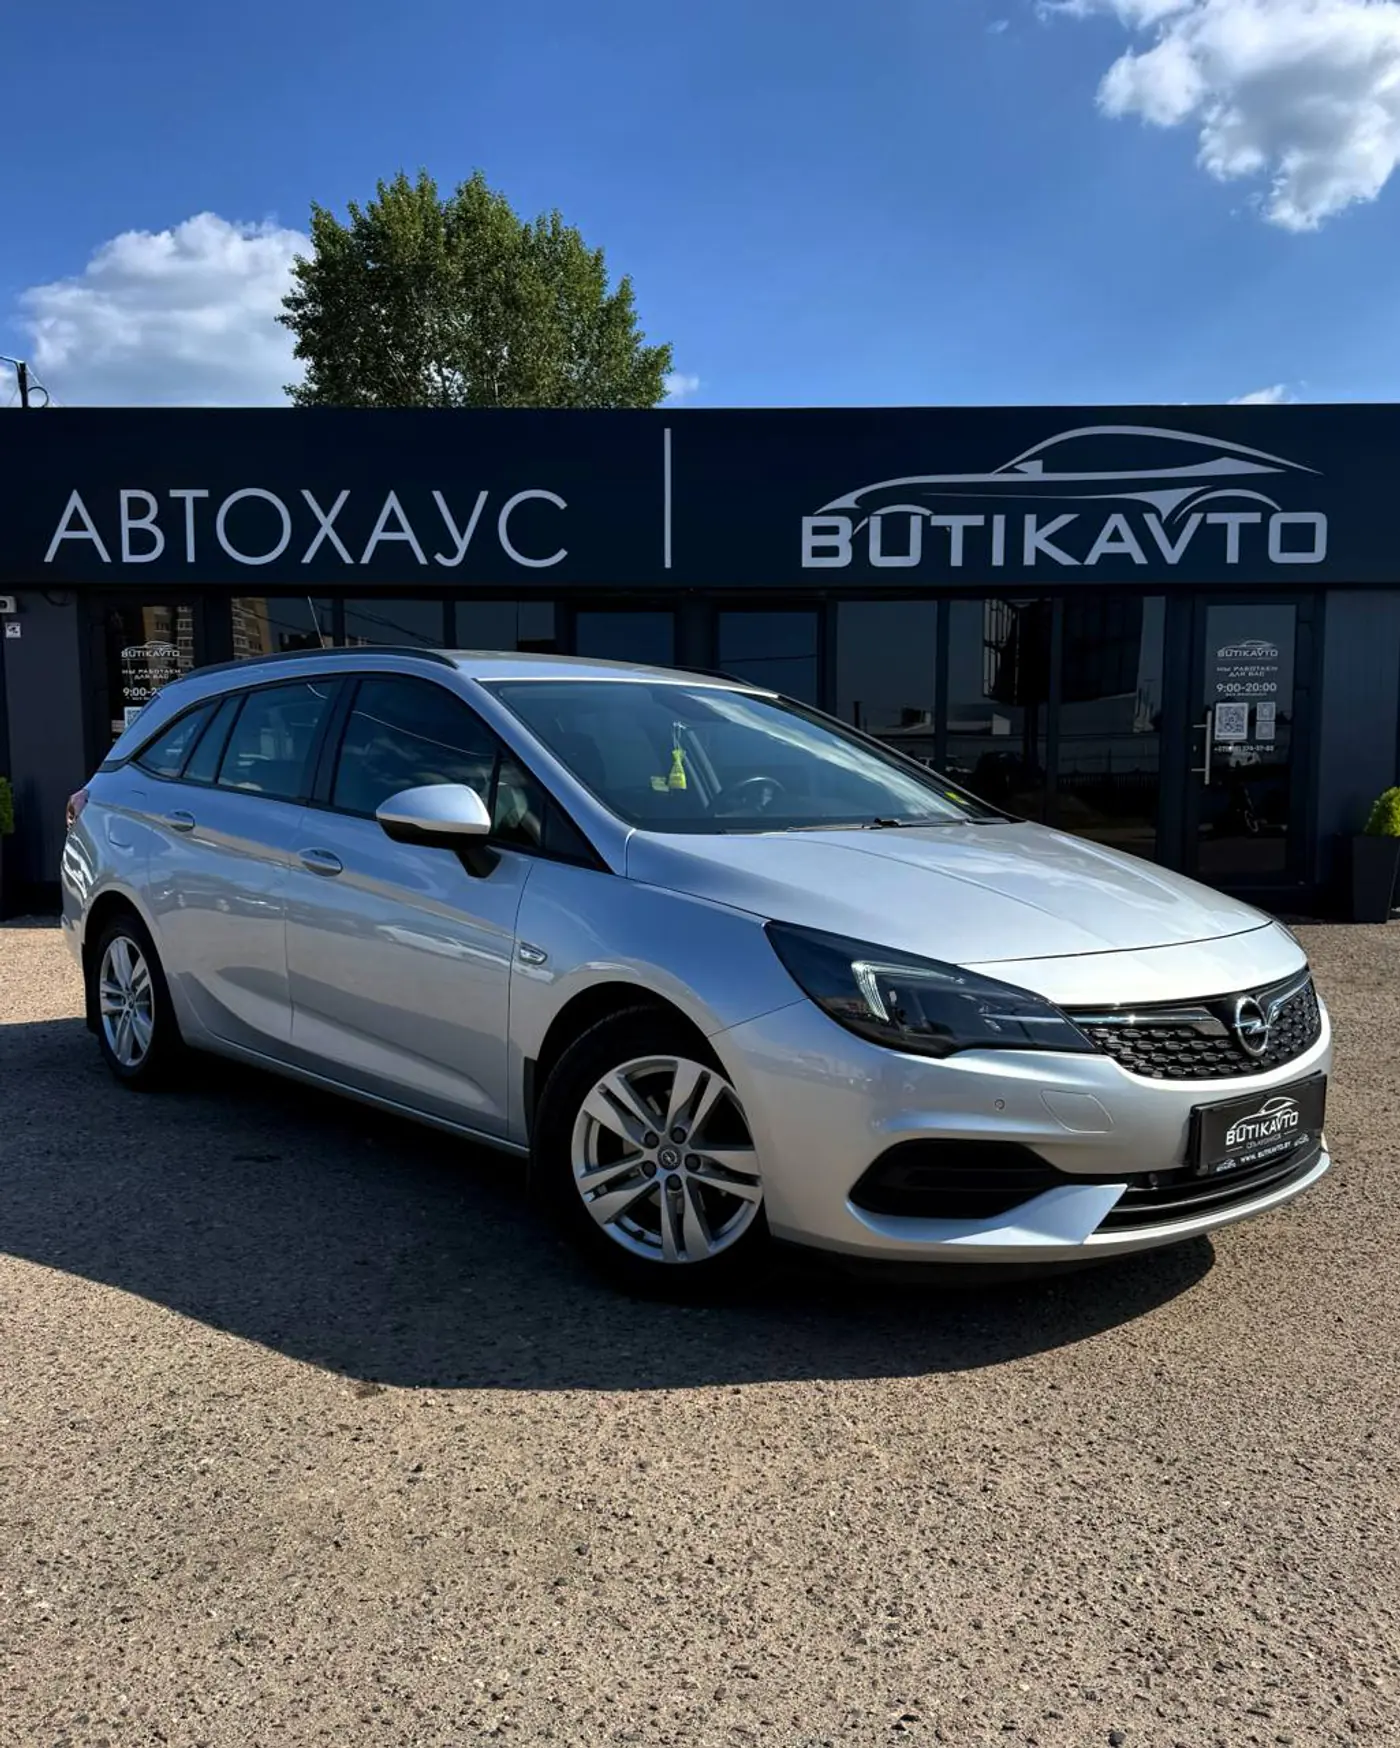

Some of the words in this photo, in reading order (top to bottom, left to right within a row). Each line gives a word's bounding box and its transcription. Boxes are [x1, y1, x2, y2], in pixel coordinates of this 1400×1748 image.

[44, 487, 568, 568] АВТОХАУС
[800, 511, 1327, 568] BUTIKAVTO
[121, 649, 180, 658] BUTIKAVTO
[1217, 649, 1278, 657] BUTIKAVTO
[1216, 682, 1277, 692] 9:00-20:00
[1225, 1111, 1299, 1146] BUTIKAVTO
